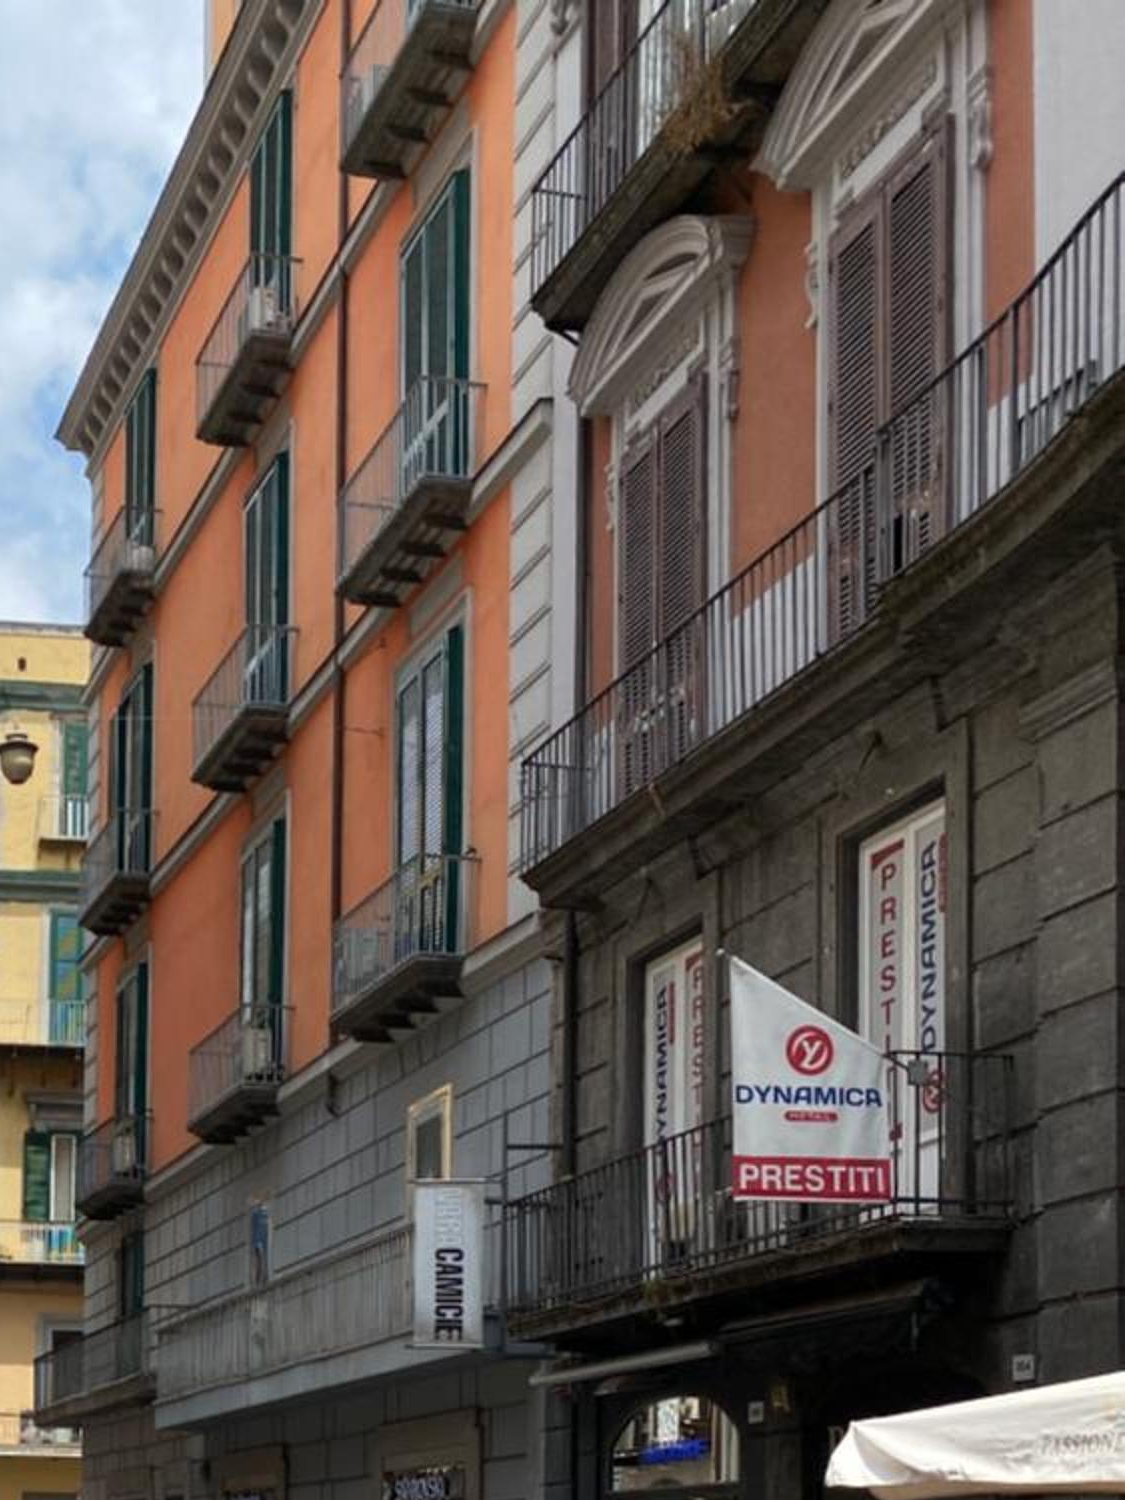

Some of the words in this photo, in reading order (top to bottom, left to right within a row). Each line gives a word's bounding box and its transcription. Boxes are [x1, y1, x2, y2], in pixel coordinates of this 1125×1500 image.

[919, 840, 938, 1054] DYNAMICA
[735, 1085, 883, 1107] DYNAMICA
[739, 1163, 885, 1193] PRESTITI
[435, 1247, 464, 1341] CAMICIE
